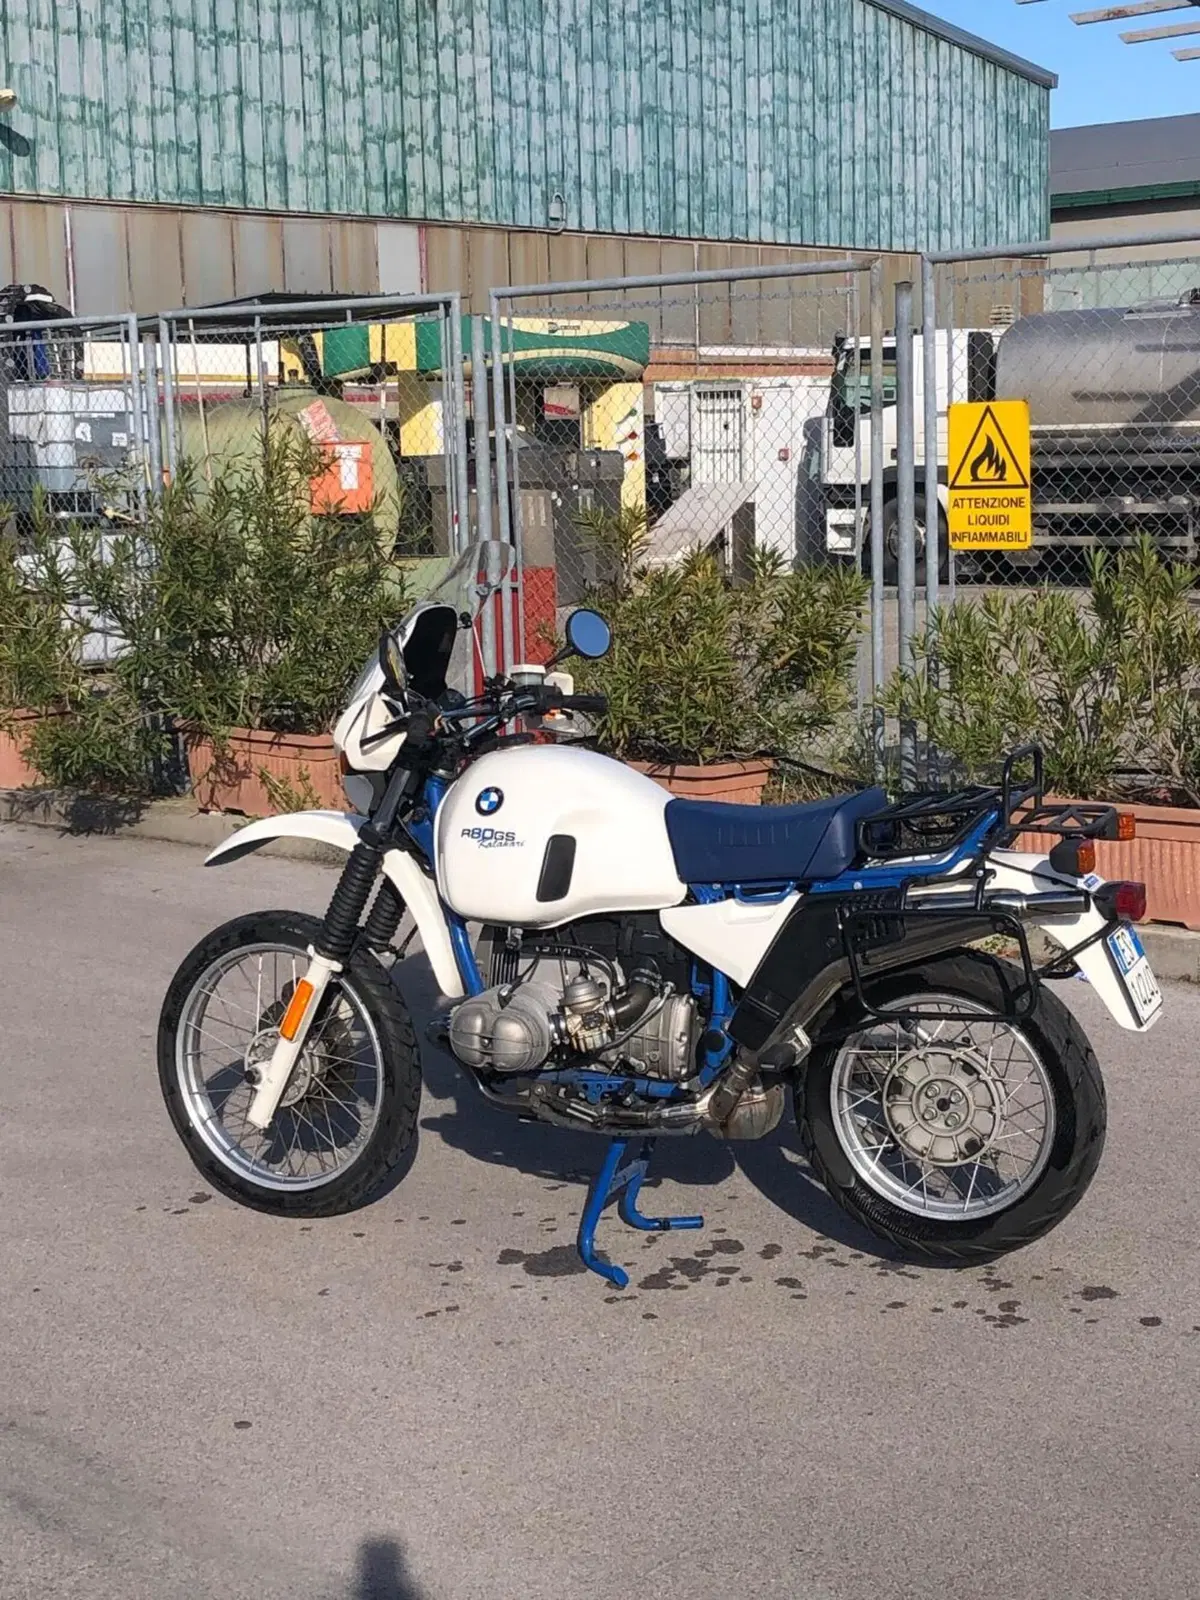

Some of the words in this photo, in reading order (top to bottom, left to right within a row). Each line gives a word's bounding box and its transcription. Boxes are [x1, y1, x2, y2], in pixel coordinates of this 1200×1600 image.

[952, 497, 1026, 509] ATTENZIONE
[968, 514, 1010, 526] LIQUIDI
[951, 531, 1027, 543] INFIAMMABILI
